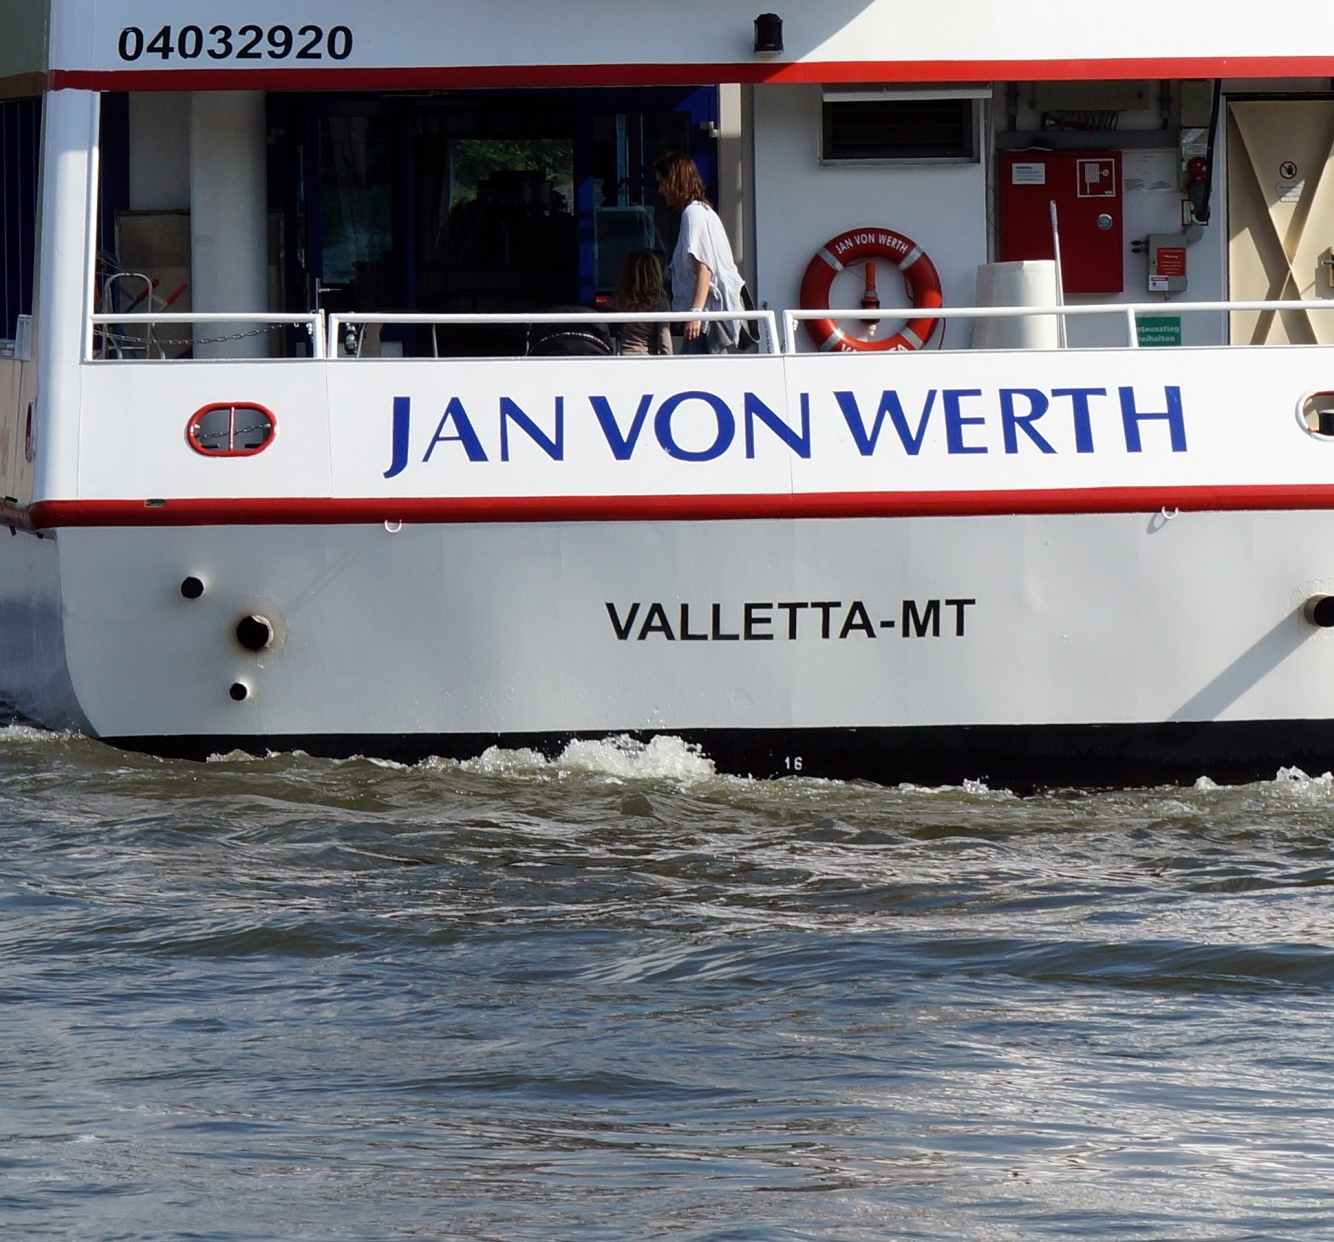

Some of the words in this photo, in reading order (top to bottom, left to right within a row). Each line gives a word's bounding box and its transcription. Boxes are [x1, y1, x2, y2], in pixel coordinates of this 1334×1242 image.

[117, 24, 354, 62] 04032920
[835, 237, 854, 254] JAN
[853, 233, 876, 245] VON
[878, 233, 909, 254] WERTH
[382, 396, 565, 478] JAN
[589, 391, 812, 462] VON
[835, 386, 1188, 456] WERTH
[605, 598, 976, 641] VALLETTA-MT
[784, 756, 803, 771] 16
